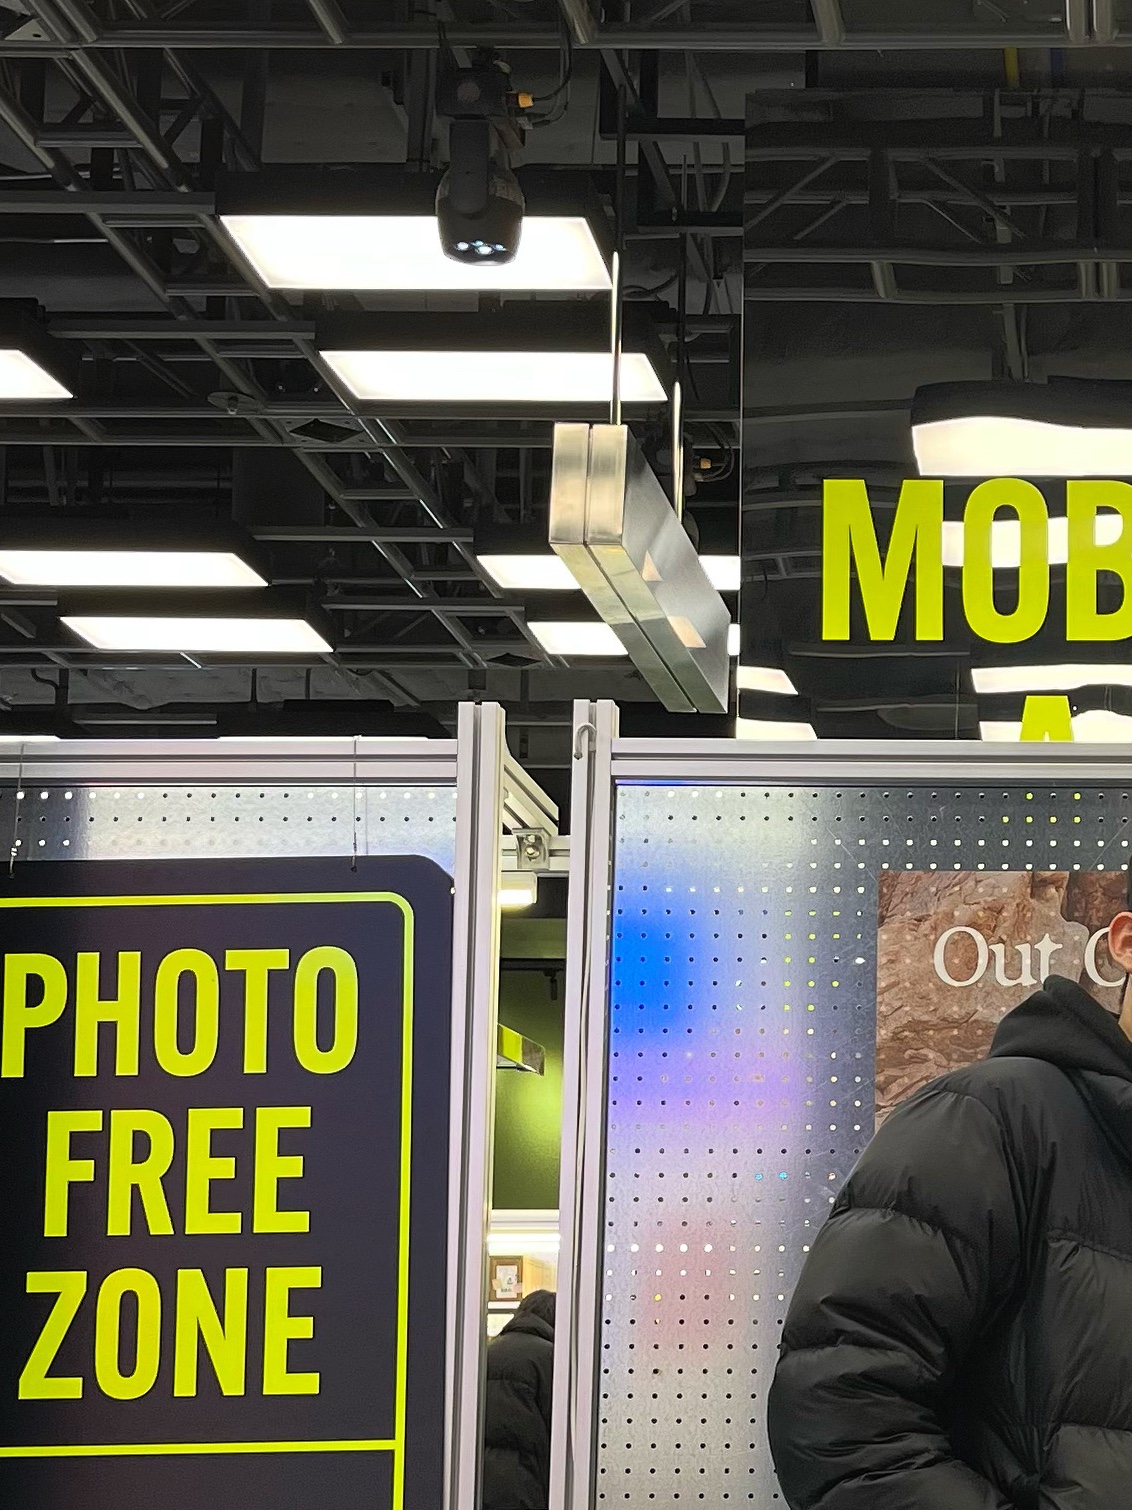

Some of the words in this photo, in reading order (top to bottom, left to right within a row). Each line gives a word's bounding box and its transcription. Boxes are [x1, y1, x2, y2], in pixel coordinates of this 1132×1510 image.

[0, 946, 359, 1078] PHOTO
[933, 926, 1063, 987] Out
[43, 1106, 312, 1237] FREE
[17, 1266, 322, 1400] ZONE
